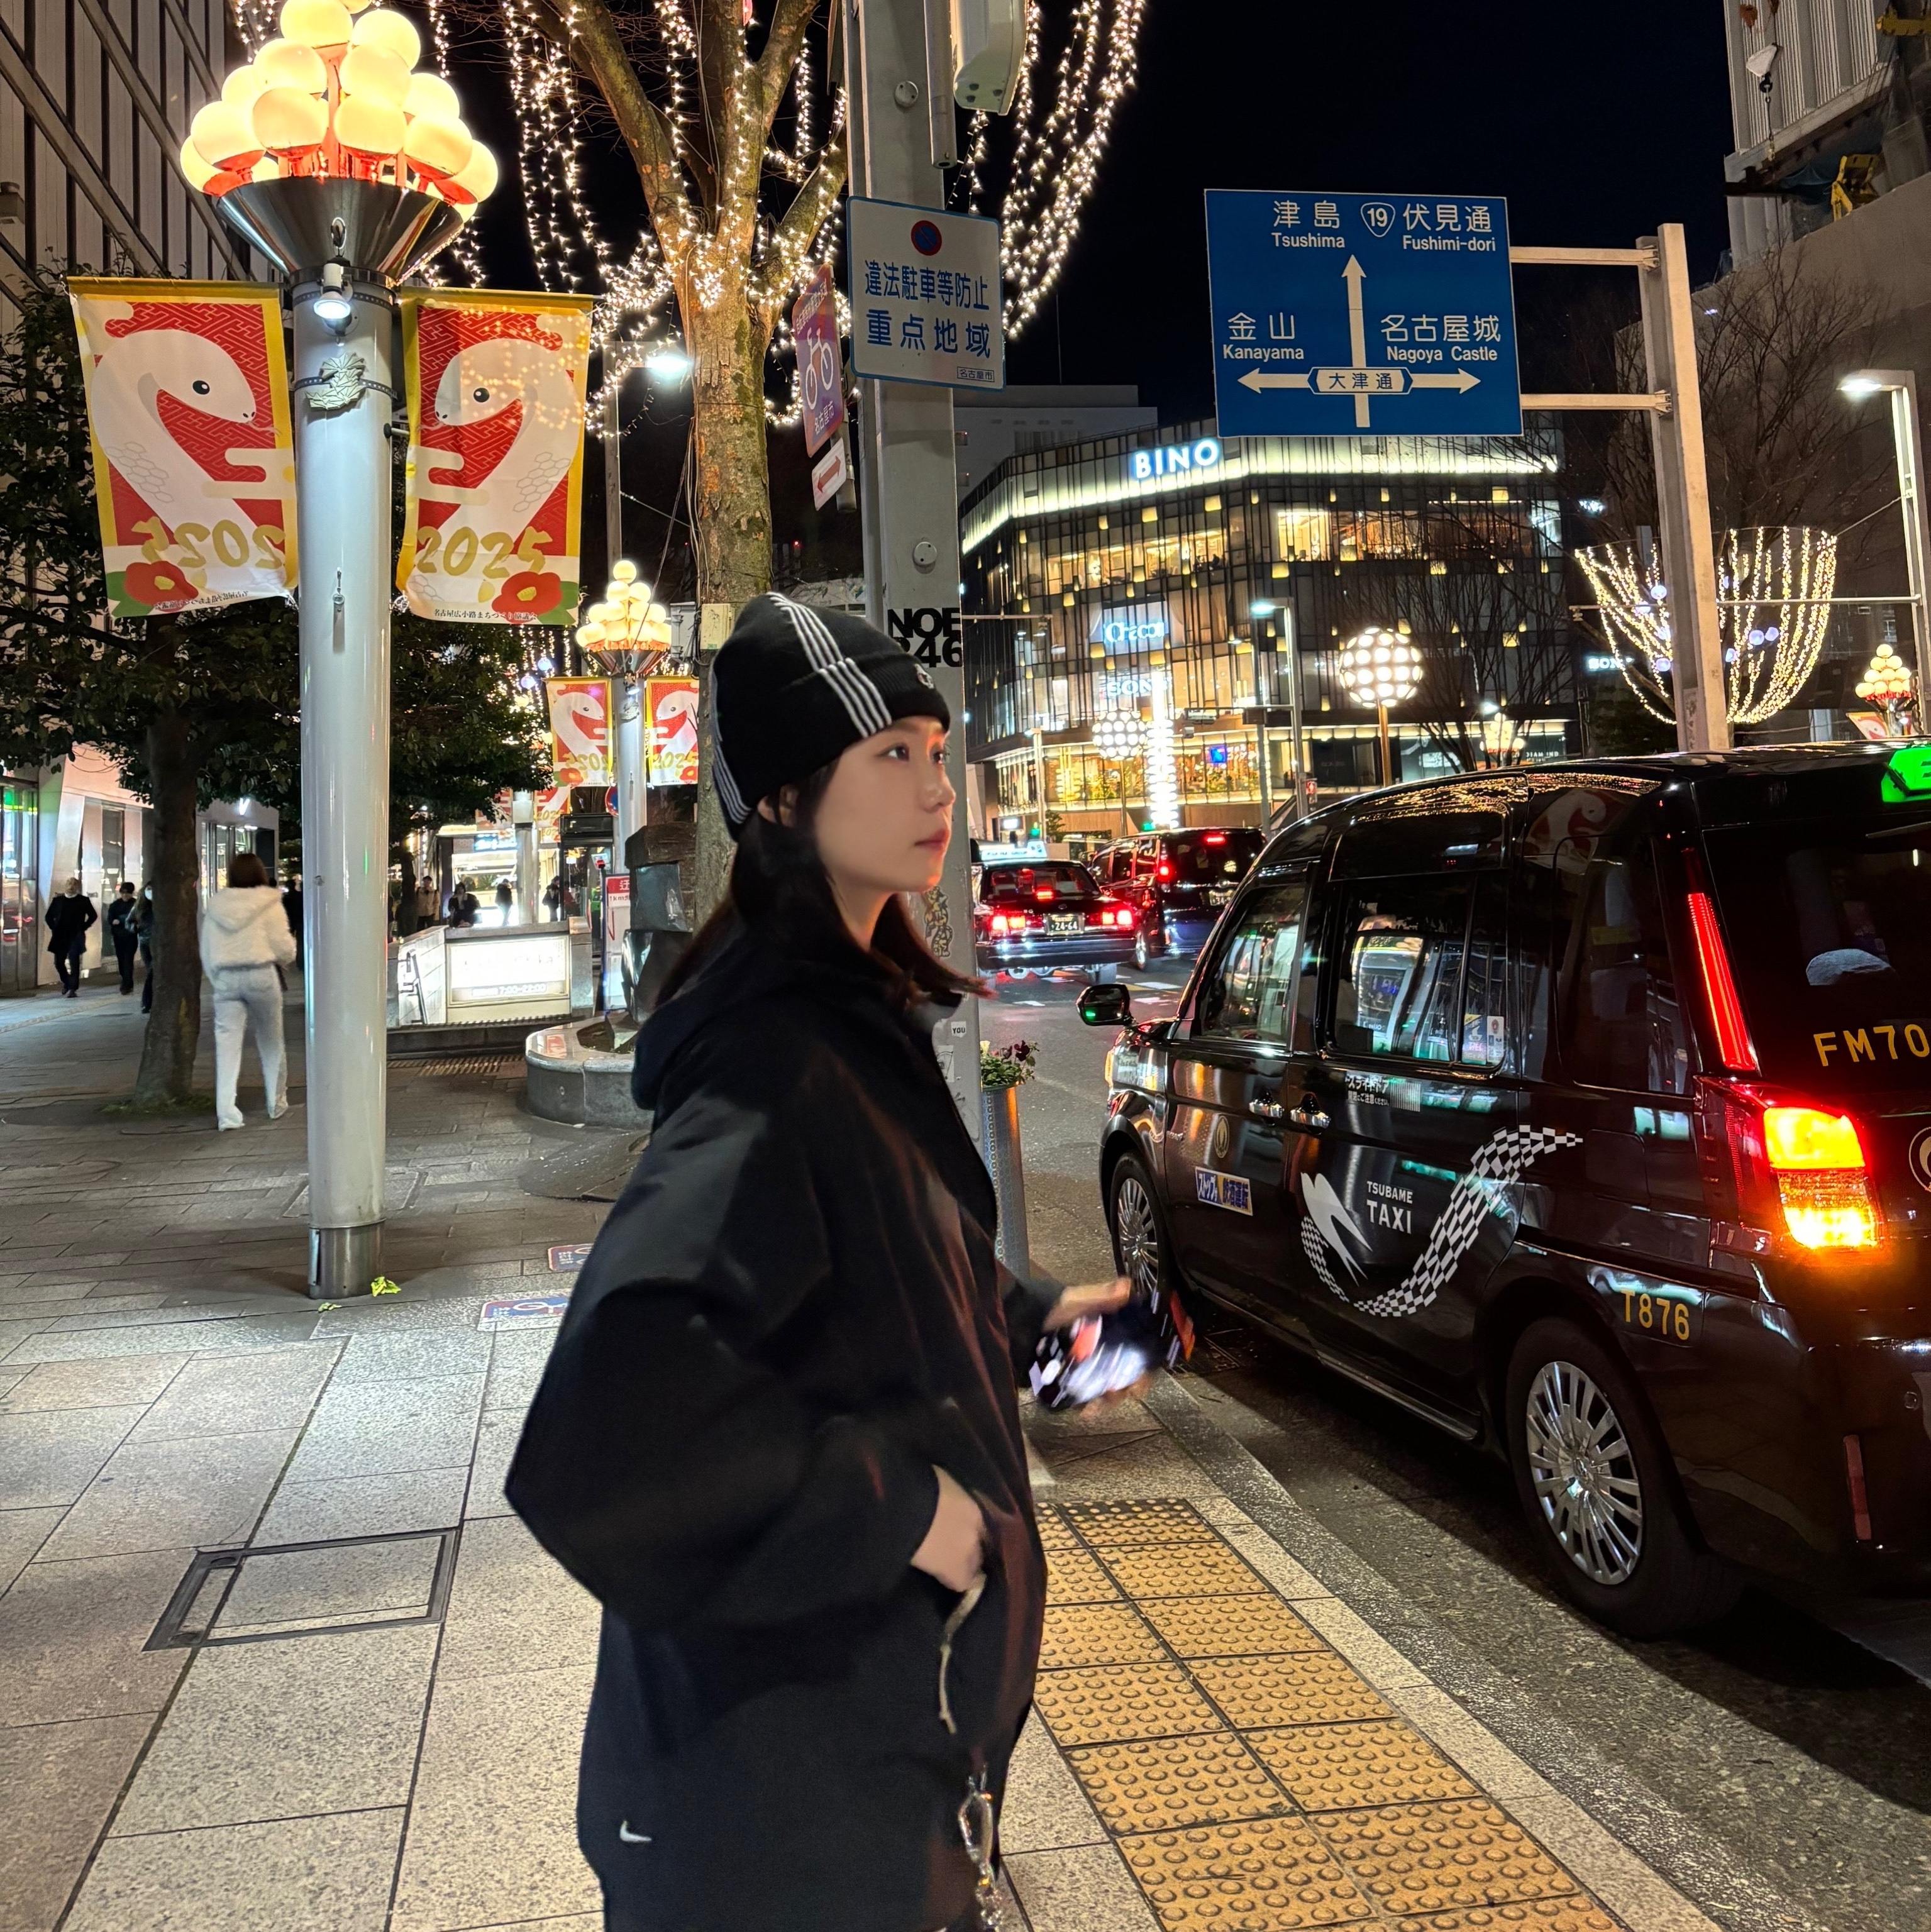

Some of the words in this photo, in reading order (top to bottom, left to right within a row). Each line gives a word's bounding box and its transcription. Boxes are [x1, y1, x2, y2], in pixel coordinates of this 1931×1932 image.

[1273, 200, 1340, 228] 津島
[1367, 208, 1387, 227] 19
[1403, 204, 1492, 232] 伏見通
[1271, 233, 1345, 248] Tsushima
[1403, 235, 1496, 251] Fushimi-dori
[865, 260, 989, 311] 違法駐車等防止
[866, 309, 991, 358] 重点地域
[1228, 312, 1296, 340] 金山
[1381, 314, 1500, 342] 名古屋城
[1223, 344, 1304, 362] Kanayama
[1387, 346, 1442, 363] Nagoya
[1451, 346, 1497, 362] Castle
[960, 369, 992, 380] 名古屋市
[1329, 372, 1393, 390] 大津通
[814, 400, 834, 434] 名古屋市
[1134, 438, 1219, 478] BINO
[416, 526, 553, 579] 2025
[888, 607, 961, 638] NOE
[1055, 921, 1078, 930] 24-64
[1366, 1181, 1413, 1204] TSUBAME
[1366, 1199, 1412, 1234] TAXI
[1620, 1289, 1690, 1340] T876
